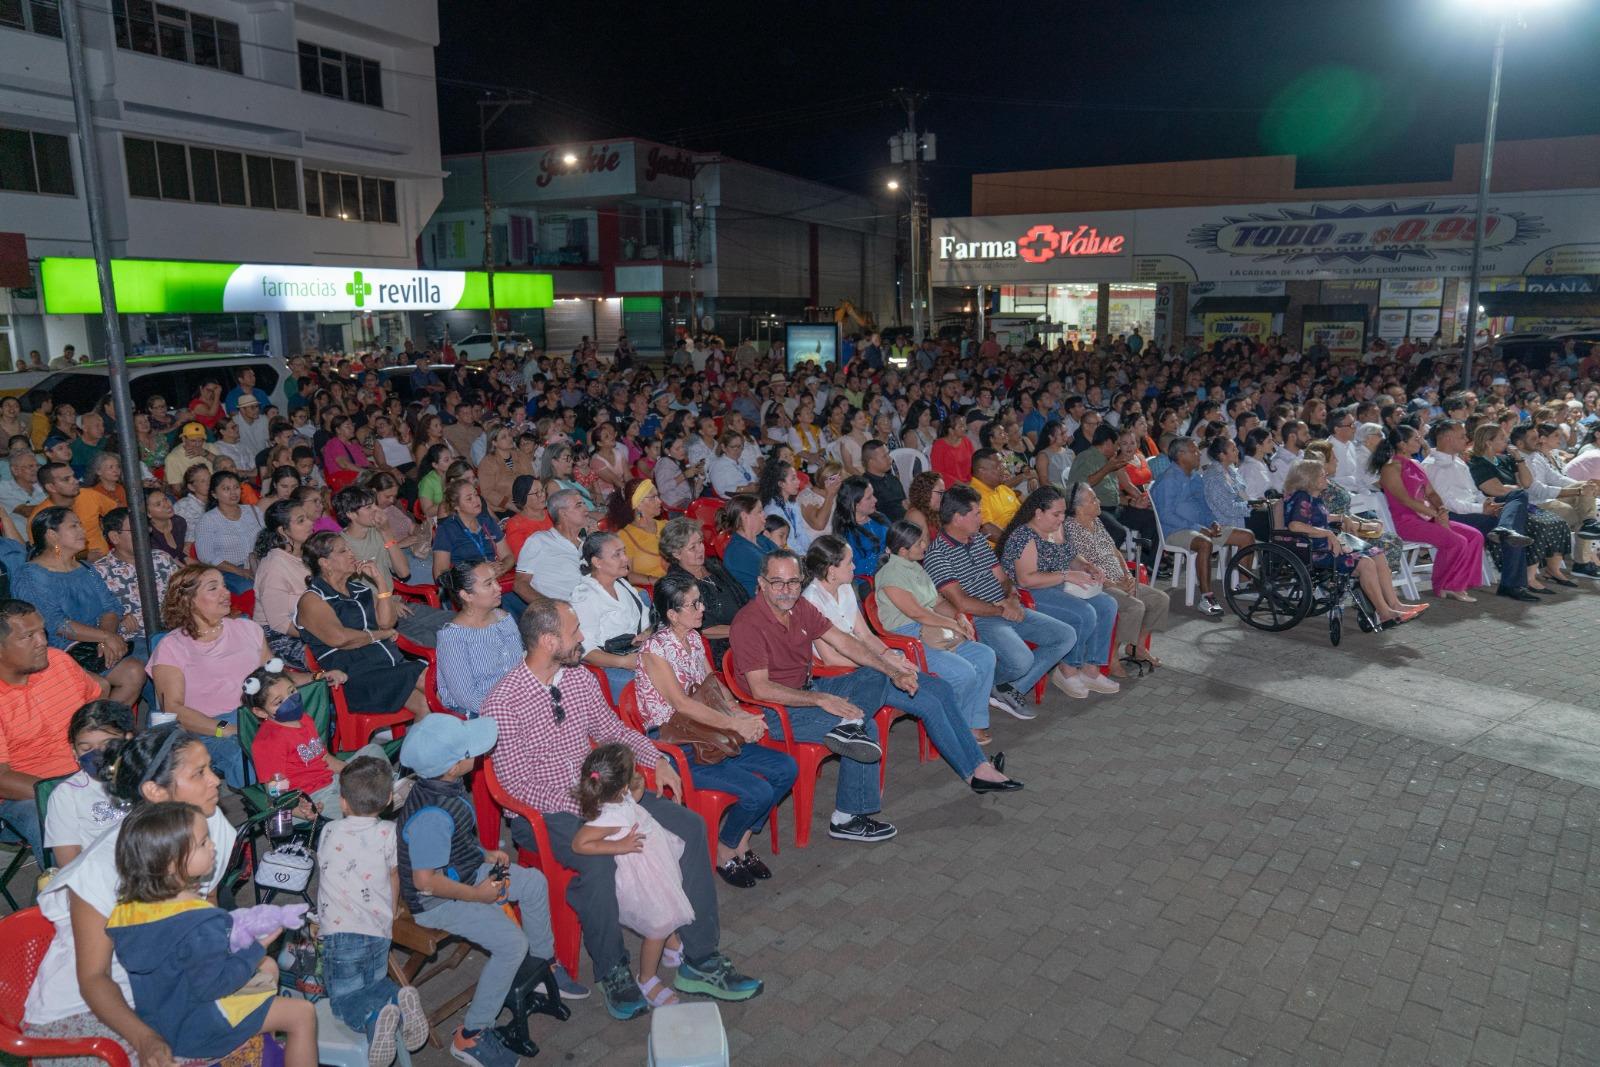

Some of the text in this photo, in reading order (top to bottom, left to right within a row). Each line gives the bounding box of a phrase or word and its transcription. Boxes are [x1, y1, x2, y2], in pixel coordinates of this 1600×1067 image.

[536, 145, 621, 187] Jakie
[939, 225, 1125, 259] Farma Value
[1232, 215, 1500, 247] TODO a $0.99
[262, 276, 441, 304] farmacias revilla
